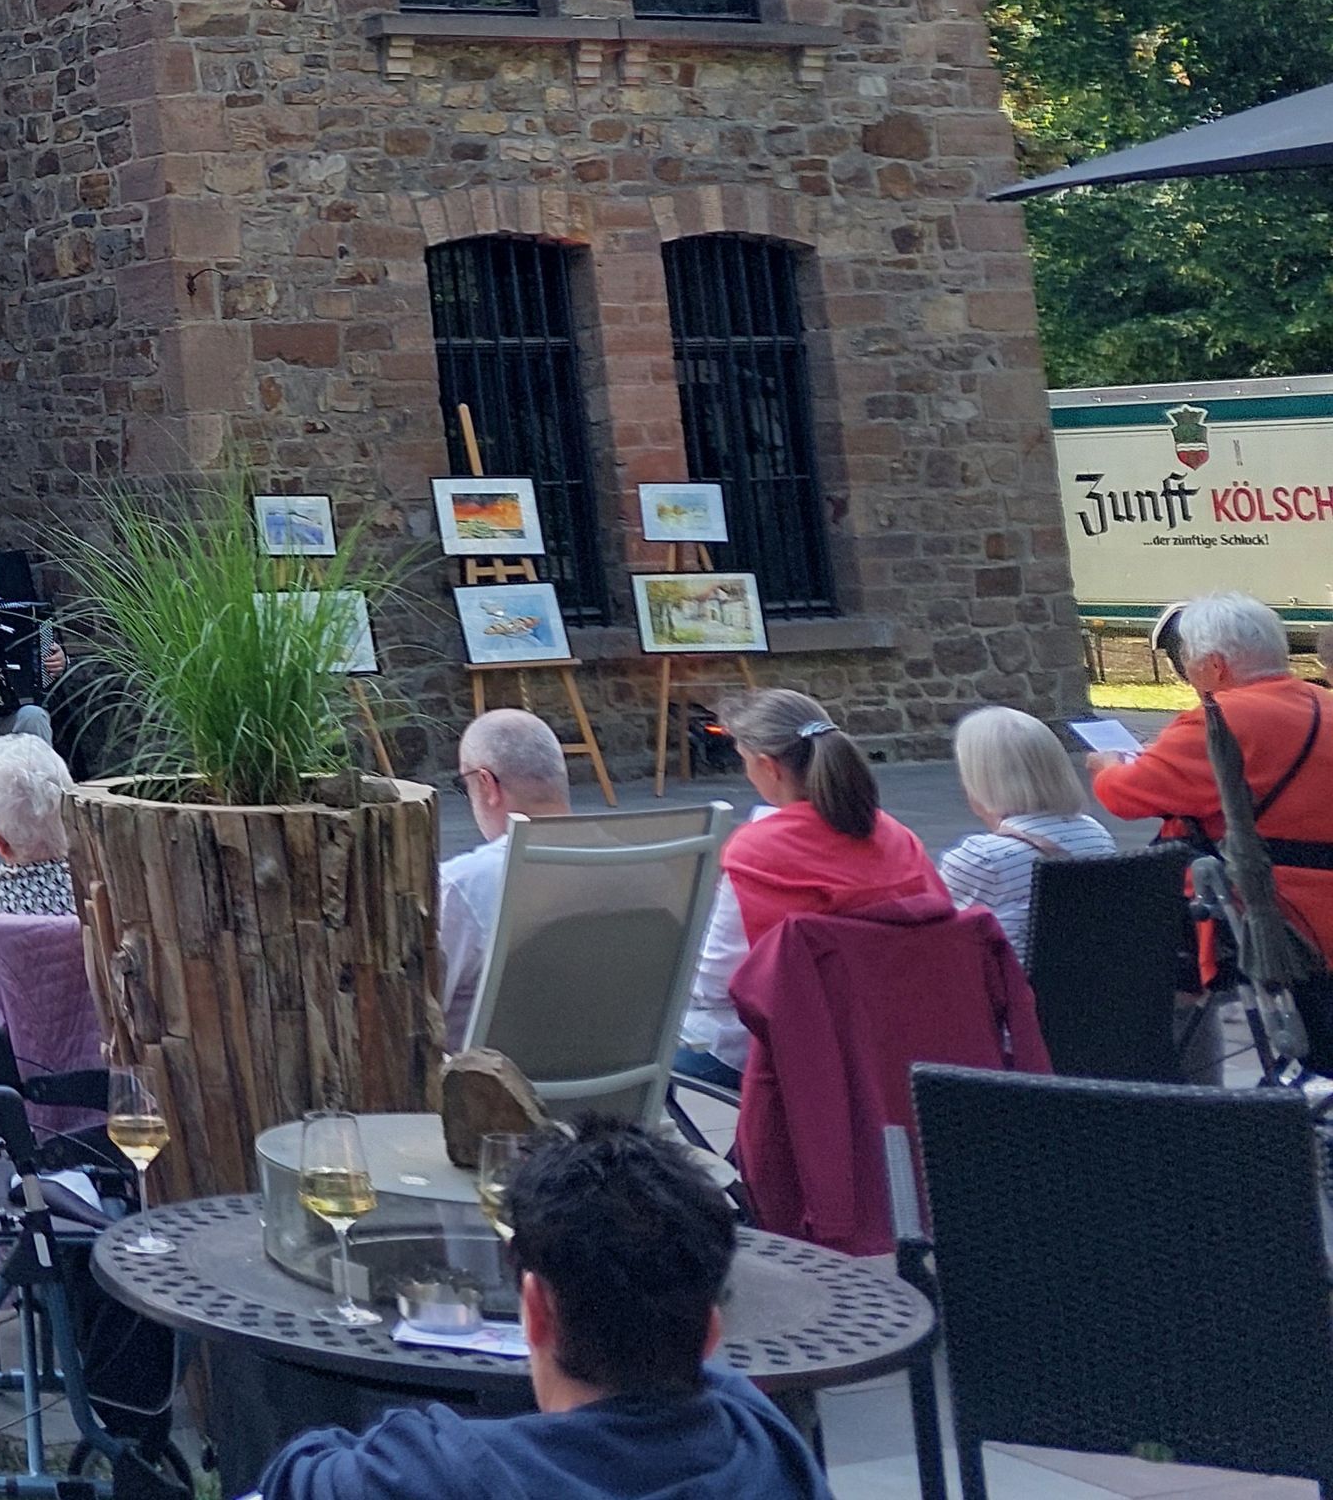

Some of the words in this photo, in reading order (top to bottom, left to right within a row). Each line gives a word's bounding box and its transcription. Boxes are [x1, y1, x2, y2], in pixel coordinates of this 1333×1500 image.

[1075, 471, 1201, 537] Zunft
[1212, 481, 1333, 523] KÖLSCH
[1173, 534, 1217, 548] zünftige
[1220, 534, 1269, 546] Schluck!
